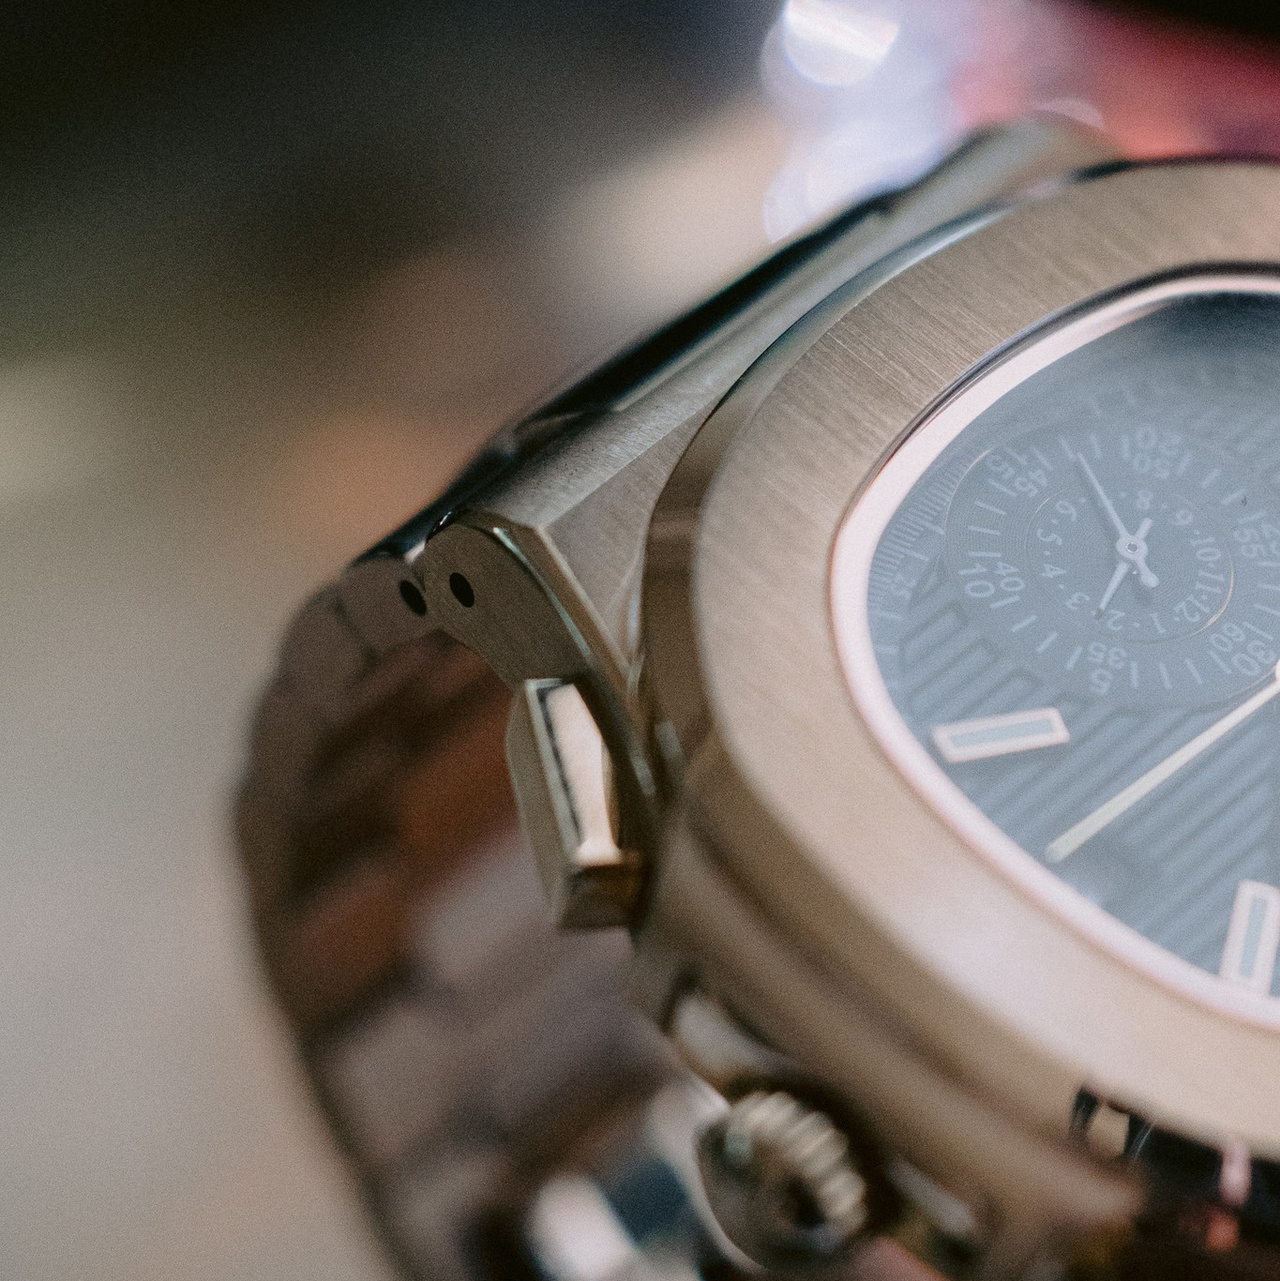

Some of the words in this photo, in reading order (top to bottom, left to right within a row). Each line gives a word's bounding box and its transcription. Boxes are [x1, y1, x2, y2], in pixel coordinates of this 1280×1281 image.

[985, 445, 1029, 478] 15
[1013, 468, 1048, 496] 45
[1135, 489, 1152, 509] 8
[1036, 527, 1062, 545] 5
[1189, 535, 1221, 561] 10
[1234, 526, 1261, 558] 55
[957, 562, 995, 597] 10
[994, 560, 1025, 592] 40
[1041, 562, 1065, 578] 4
[1194, 568, 1223, 594] 11
[1064, 591, 1089, 611] 3
[1172, 594, 1209, 623] 12
[1106, 609, 1124, 630] 2
[1148, 612, 1166, 633] 1
[1209, 622, 1244, 652] 60
[1087, 641, 1127, 669] 35
[1232, 640, 1276, 676] 30
[1088, 668, 1112, 694] 5
